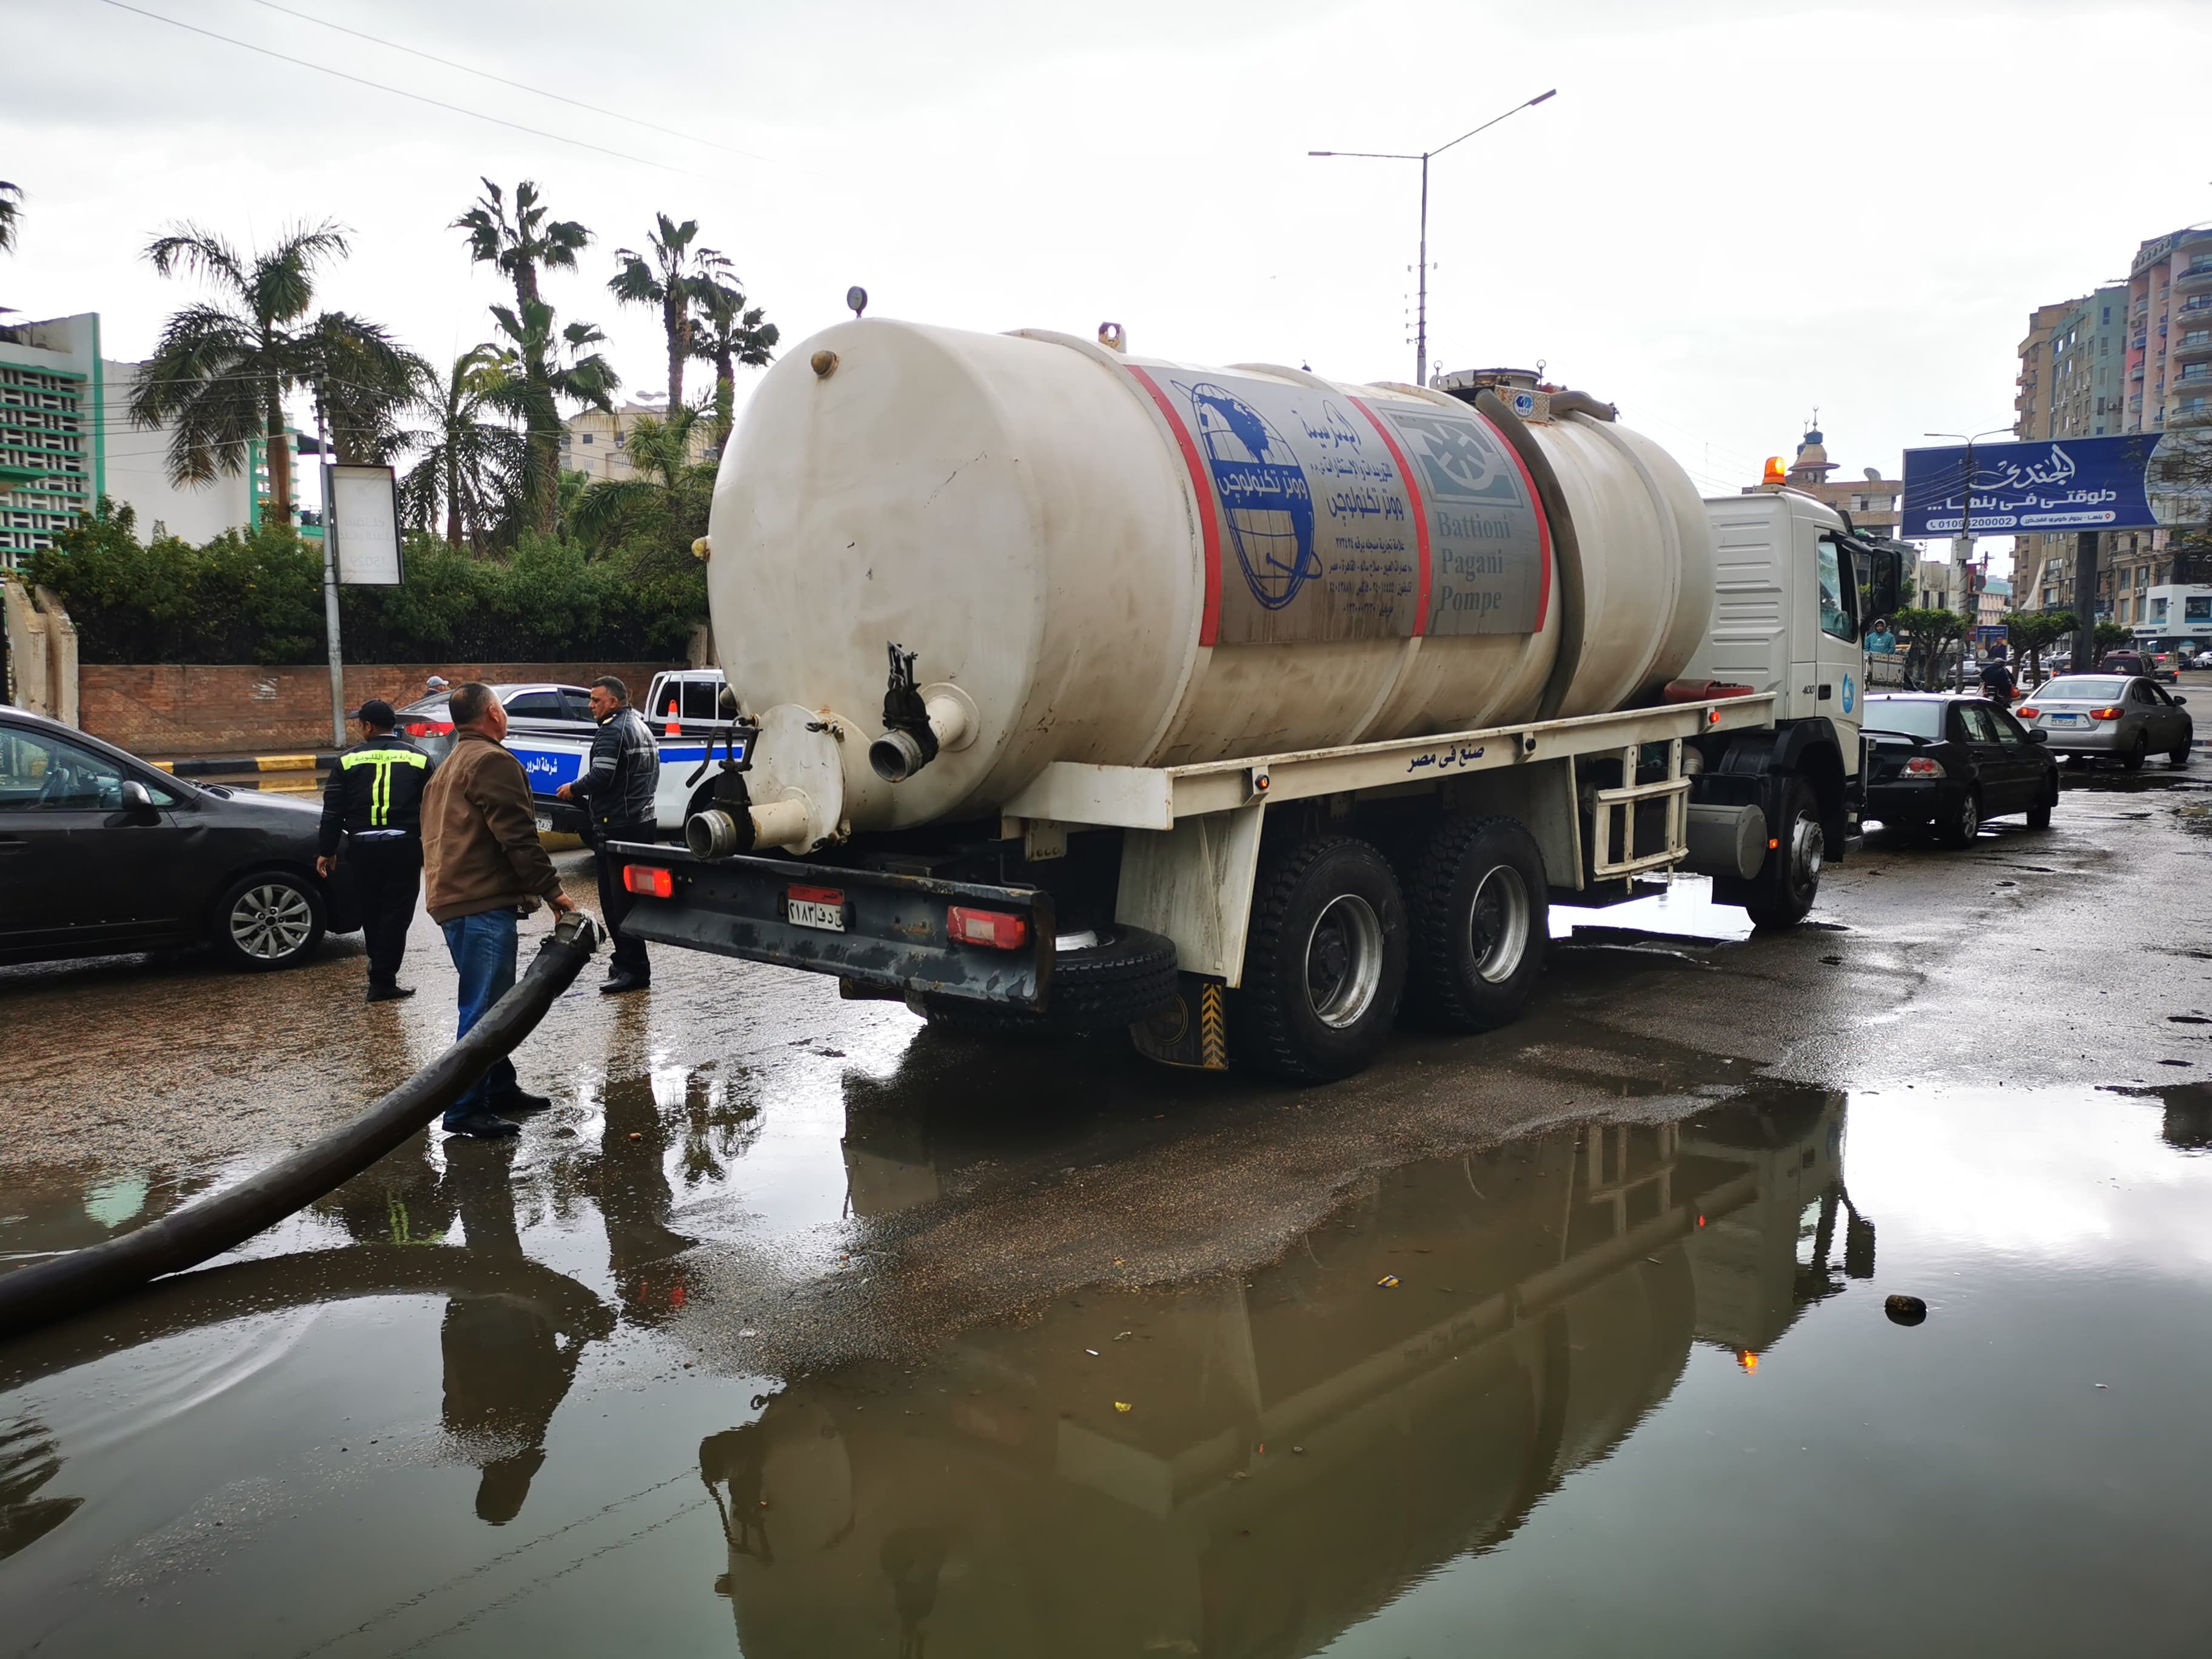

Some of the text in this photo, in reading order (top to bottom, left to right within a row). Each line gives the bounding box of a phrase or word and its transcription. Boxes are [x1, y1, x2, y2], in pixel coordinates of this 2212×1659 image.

[1282, 470, 1308, 500] ووتر
[1381, 488, 1404, 521] ووتر
[1436, 511, 1512, 539] Battioni
[1441, 548, 1504, 583] Pagani
[1438, 585, 1503, 618] Pompe
[1802, 685, 1815, 694] 400
[526, 757, 558, 776] شرطة المرور
[1406, 752, 1436, 773] مصر
[1459, 743, 1485, 767] صنع
[789, 902, 814, 923] ٢١٨٣
